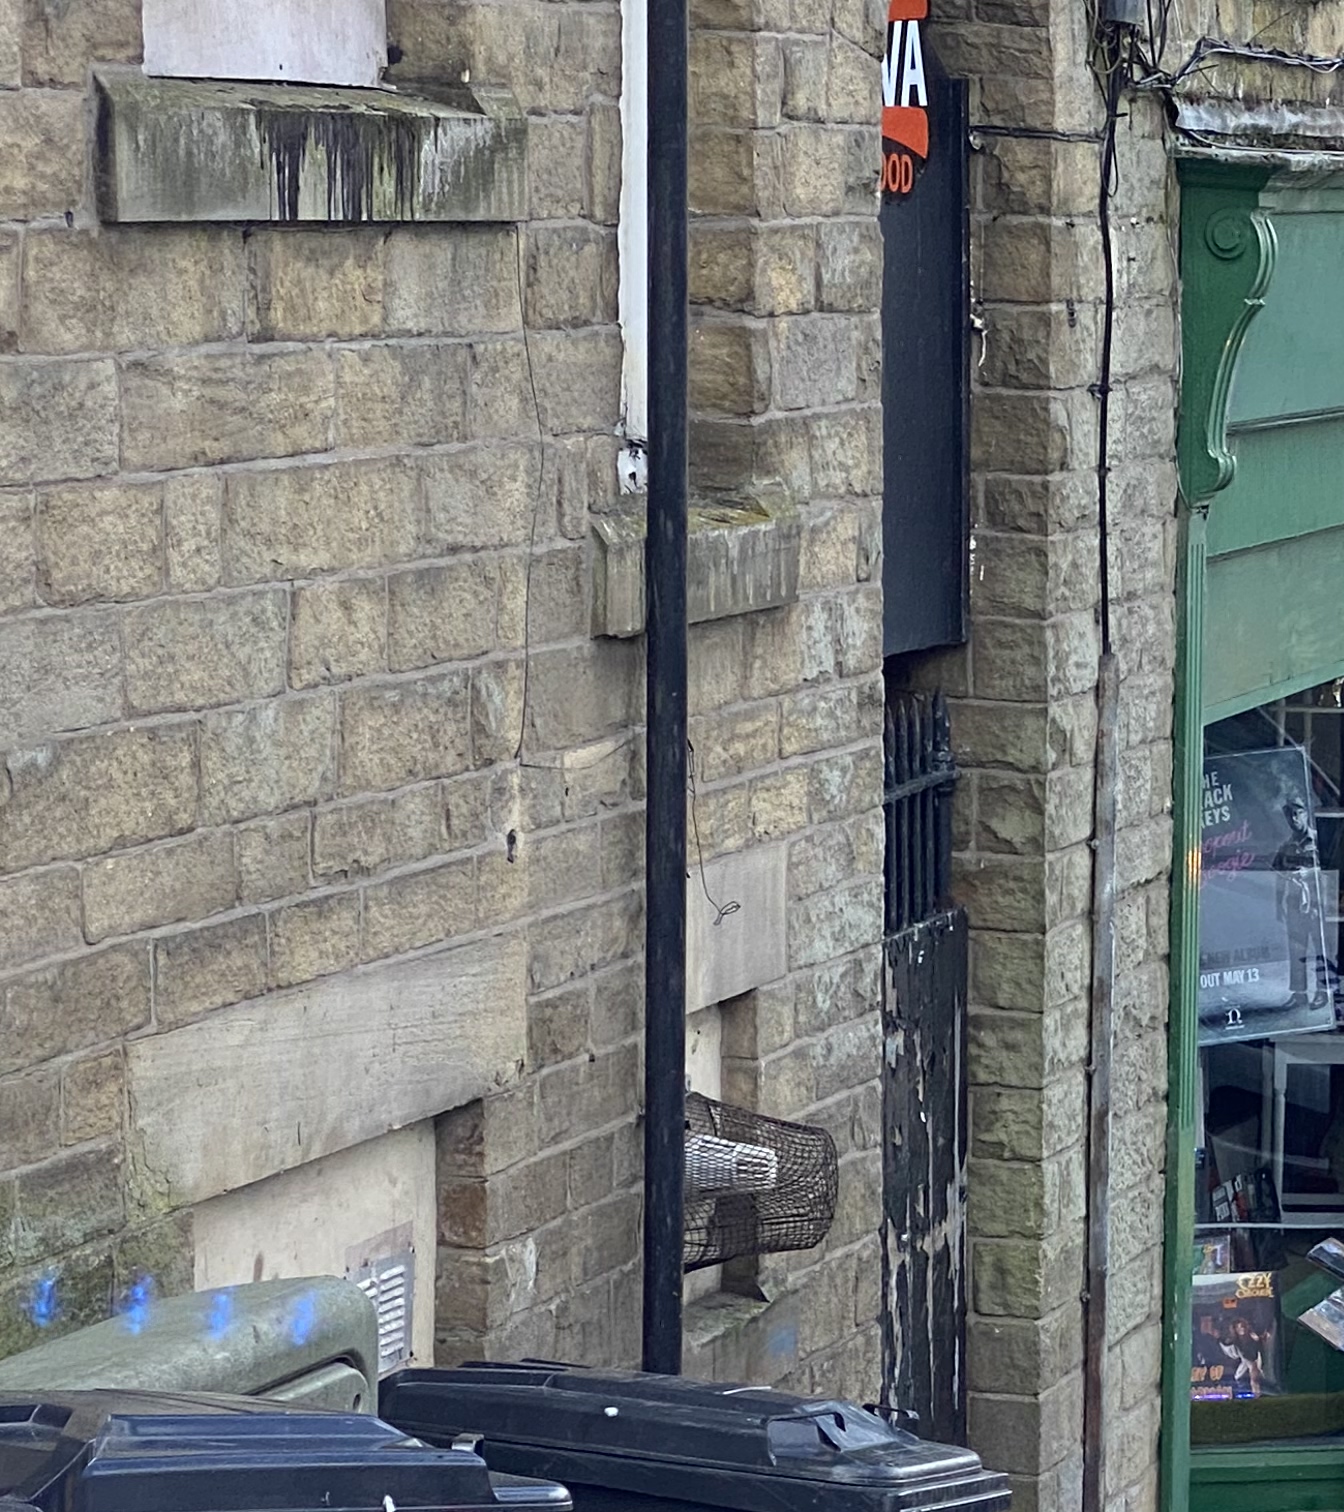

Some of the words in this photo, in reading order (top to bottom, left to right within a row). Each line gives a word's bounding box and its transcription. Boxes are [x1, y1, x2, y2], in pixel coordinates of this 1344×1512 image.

[1202, 771, 1220, 788] HE
[1204, 784, 1233, 809] ACK
[1200, 972, 1220, 988] OUT
[1223, 969, 1245, 985] MAY
[1246, 967, 1260, 983] 13
